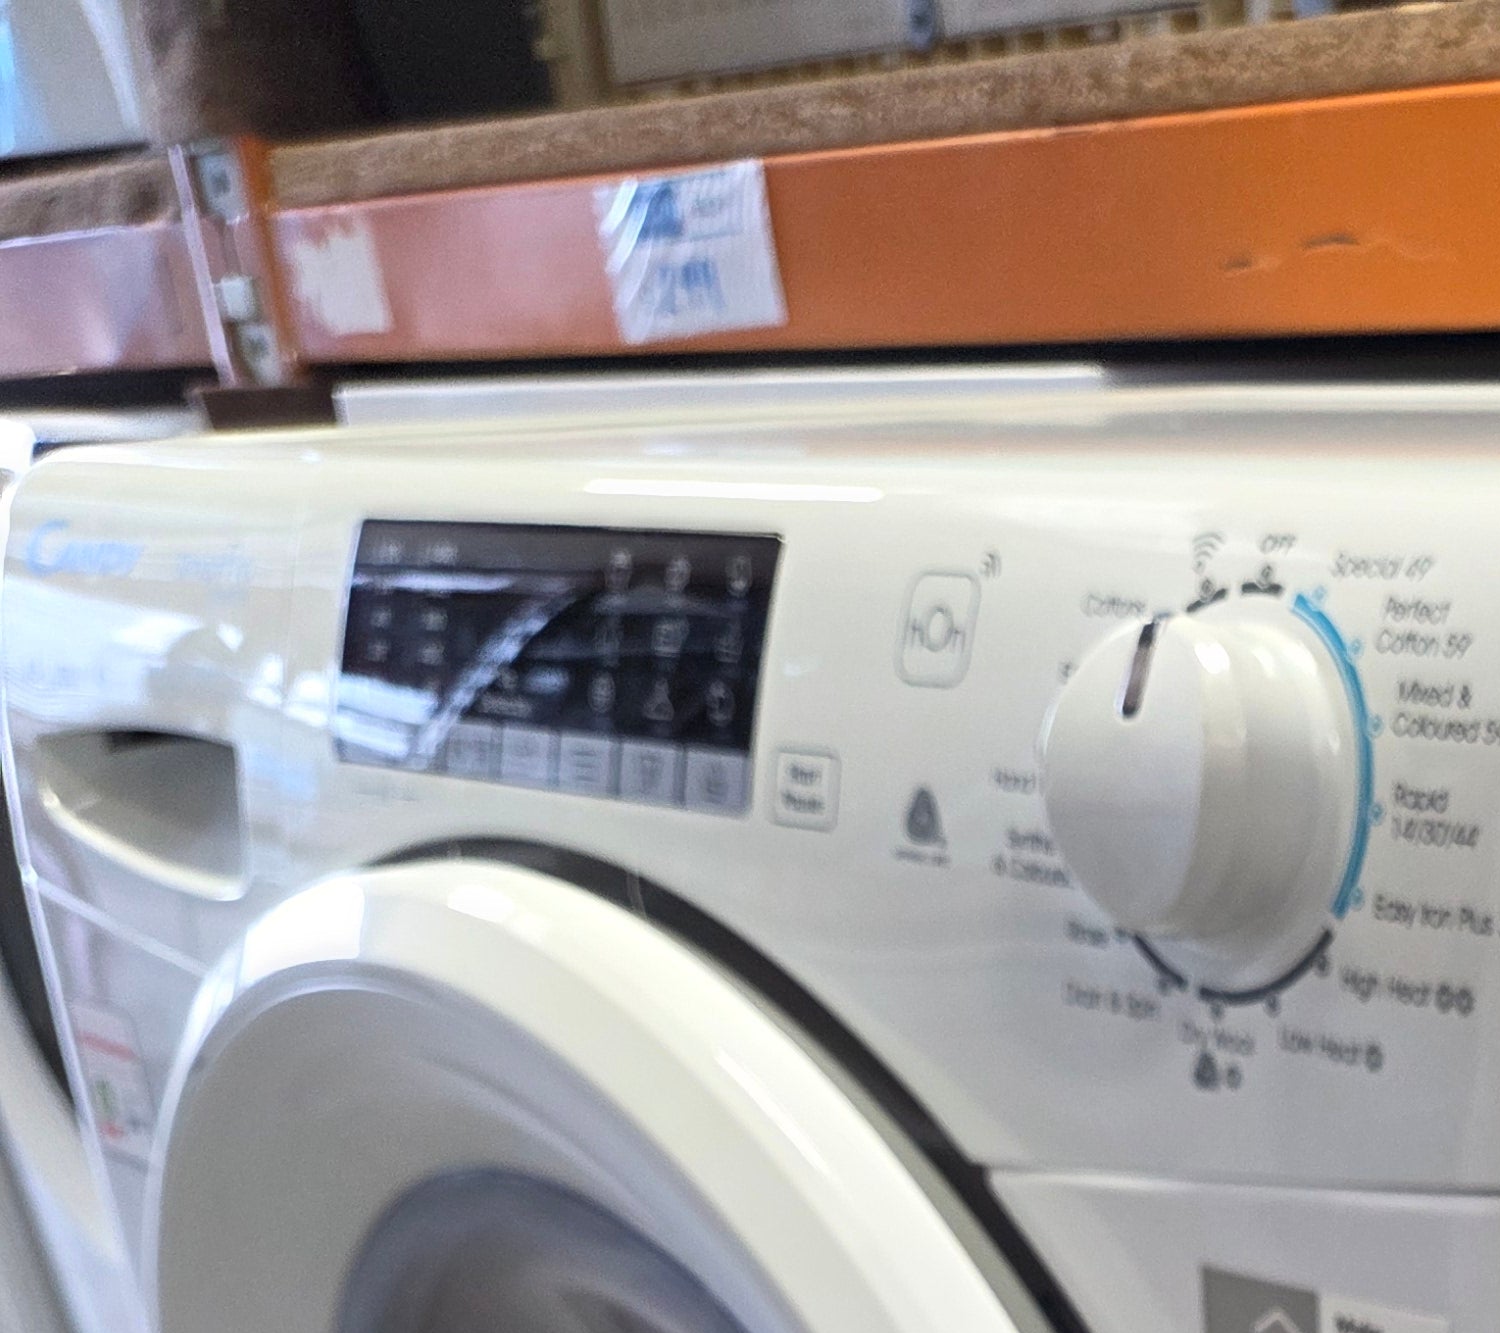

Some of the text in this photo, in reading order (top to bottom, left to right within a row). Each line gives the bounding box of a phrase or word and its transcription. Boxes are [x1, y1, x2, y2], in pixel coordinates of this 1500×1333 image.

[1382, 596, 1452, 625] Perfect
[1375, 627, 1440, 658] Cotton
[1395, 678, 1455, 708] Mixed
[1390, 711, 1481, 745] Coloured
